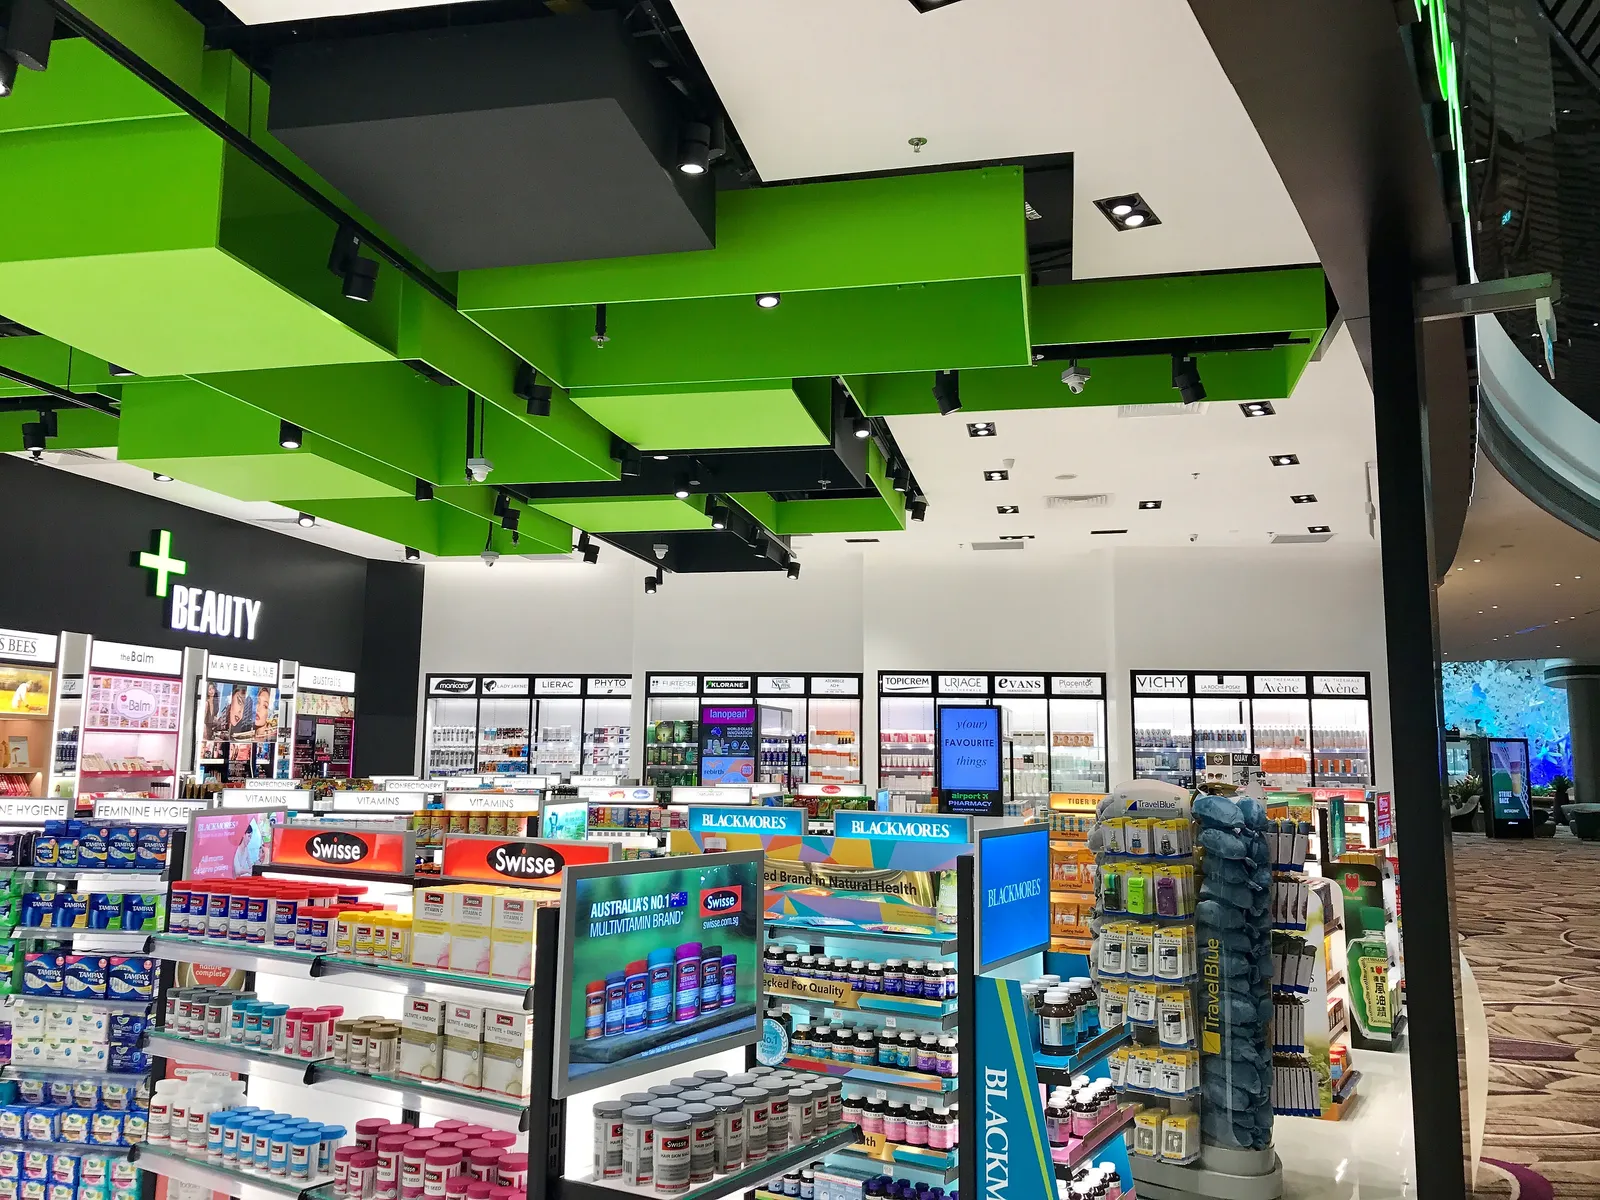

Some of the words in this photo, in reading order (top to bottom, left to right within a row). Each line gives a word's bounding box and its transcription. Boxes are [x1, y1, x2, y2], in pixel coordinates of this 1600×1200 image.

[172, 585, 261, 640] BEAUTY
[9, 638, 36, 654] BEES
[210, 662, 274, 675] MAYBELLINE
[945, 678, 981, 688] URIAGE
[1137, 677, 1186, 688] VICHY
[1262, 682, 1298, 693] Avène
[1321, 683, 1358, 693] Avène
[710, 709, 747, 720] lanopearl
[956, 719, 987, 730] y(our)
[945, 738, 994, 747] FAVOURITE
[956, 756, 987, 768] things
[246, 795, 286, 804] VITAMINS
[357, 796, 400, 806] VITAMINS
[470, 798, 514, 808] VITAMINS
[17, 805, 64, 816] HYGIENE
[98, 806, 150, 817] FEMININE
[702, 814, 786, 829] BLACKMORES
[851, 820, 950, 838] BLACKMORES
[312, 836, 361, 860] Swisse
[495, 848, 555, 874] Swisse
[780, 871, 812, 885] Brand
[815, 874, 825, 886] in
[830, 876, 871, 891] Natural
[876, 880, 916, 895] Health
[988, 878, 1041, 908] BLACKMORES
[590, 897, 648, 918] AUSTRALIA'S
[651, 894, 669, 910] NO.1
[708, 894, 734, 909] Swisse
[590, 915, 650, 937] MULTIVITAMIN
[703, 916, 738, 929] swisse.com.sg
[764, 978, 788, 989] ecked
[792, 981, 807, 991] For
[810, 983, 844, 998] Quality
[1204, 938, 1219, 1031] TravelBlue
